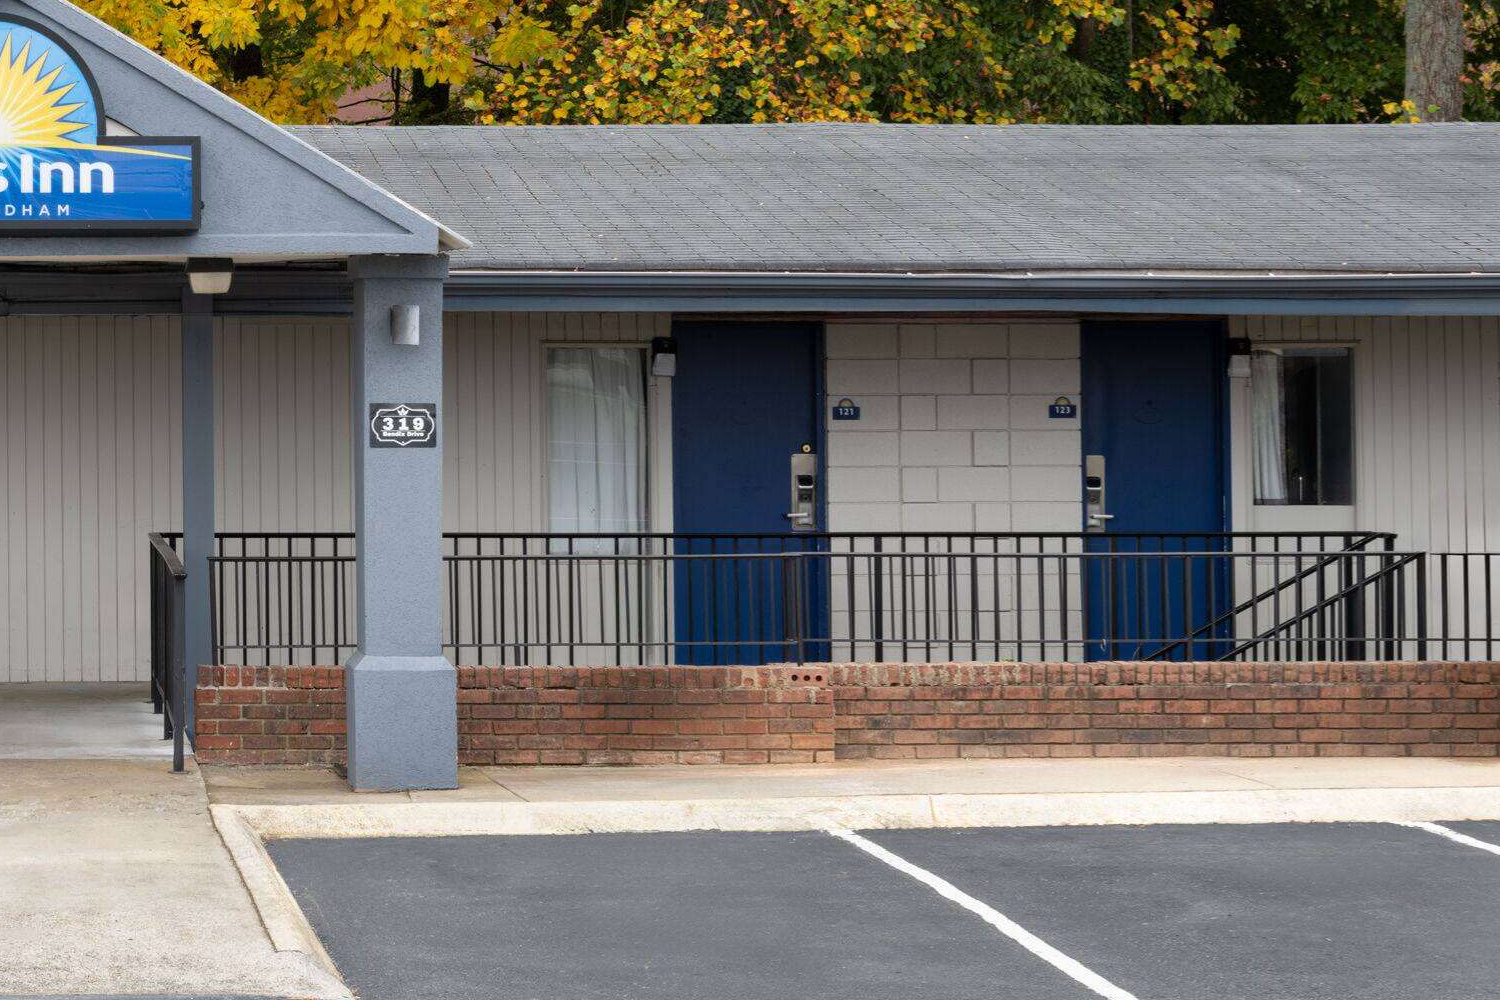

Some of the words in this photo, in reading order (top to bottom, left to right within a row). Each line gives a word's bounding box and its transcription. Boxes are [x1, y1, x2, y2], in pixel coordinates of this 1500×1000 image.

[20, 153, 116, 194] Inn
[838, 408, 855, 416] 121
[1054, 406, 1071, 414] 123
[382, 417, 425, 431] 319
